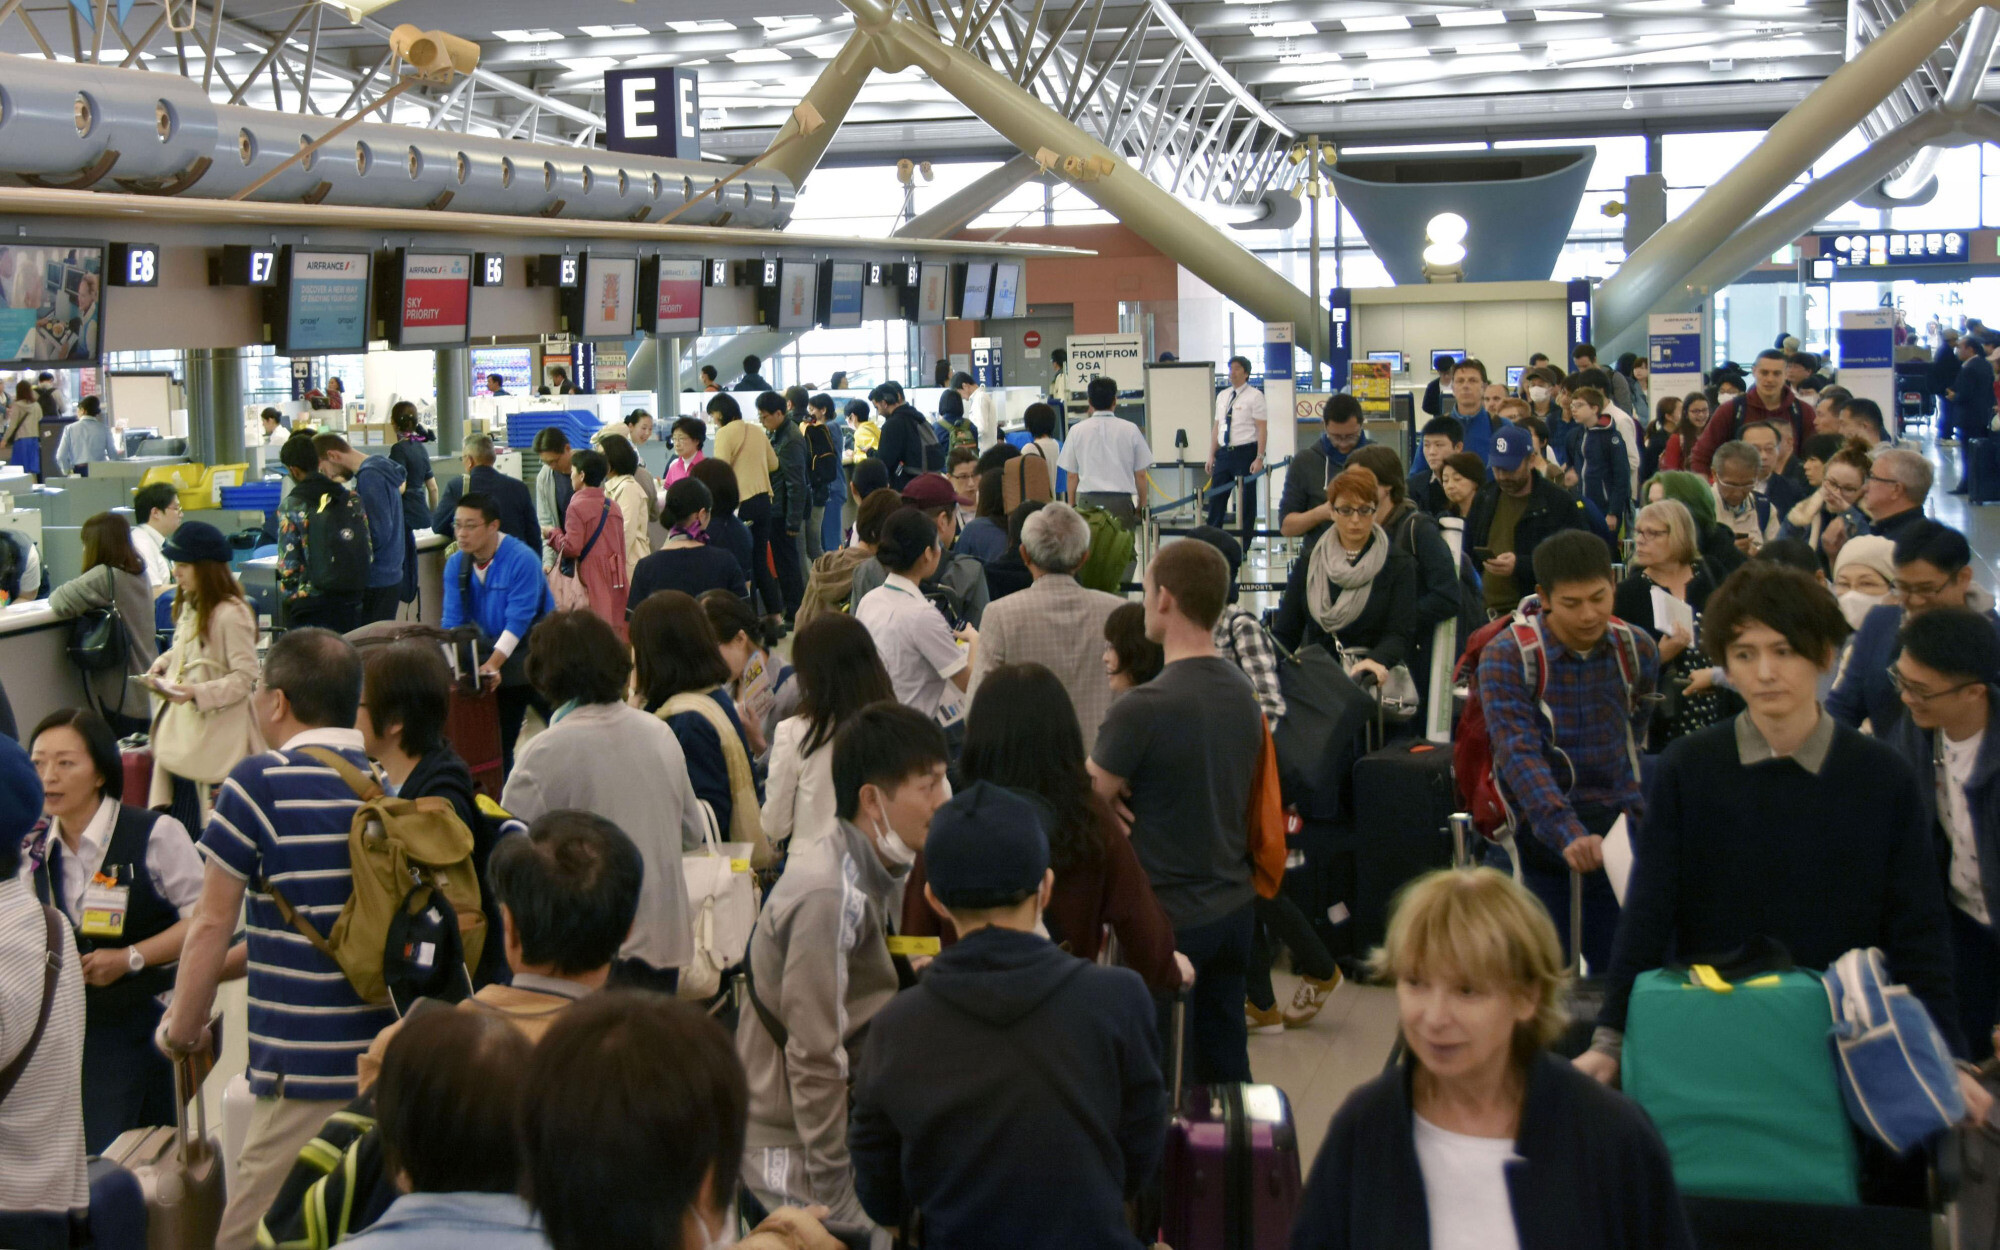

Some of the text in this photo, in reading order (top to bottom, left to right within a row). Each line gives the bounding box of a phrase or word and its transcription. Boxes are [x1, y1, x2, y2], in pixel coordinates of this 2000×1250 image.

[622, 77, 658, 138] E
[680, 77, 695, 138] E
[131, 250, 155, 282] E8
[252, 252, 274, 282] E7
[307, 261, 344, 271] AIRFRANCE
[409, 266, 438, 274] AIRFRANCE
[487, 257, 501, 282] E6
[562, 259, 576, 283] E5
[714, 263, 725, 283] E4
[765, 263, 775, 283] E3
[871, 265, 880, 283] E2
[407, 297, 422, 308] SKY
[406, 308, 440, 320] PRIORITY
[1072, 351, 1104, 359] FROM
[1105, 349, 1138, 358] FROM
[1076, 362, 1101, 371] OSA
